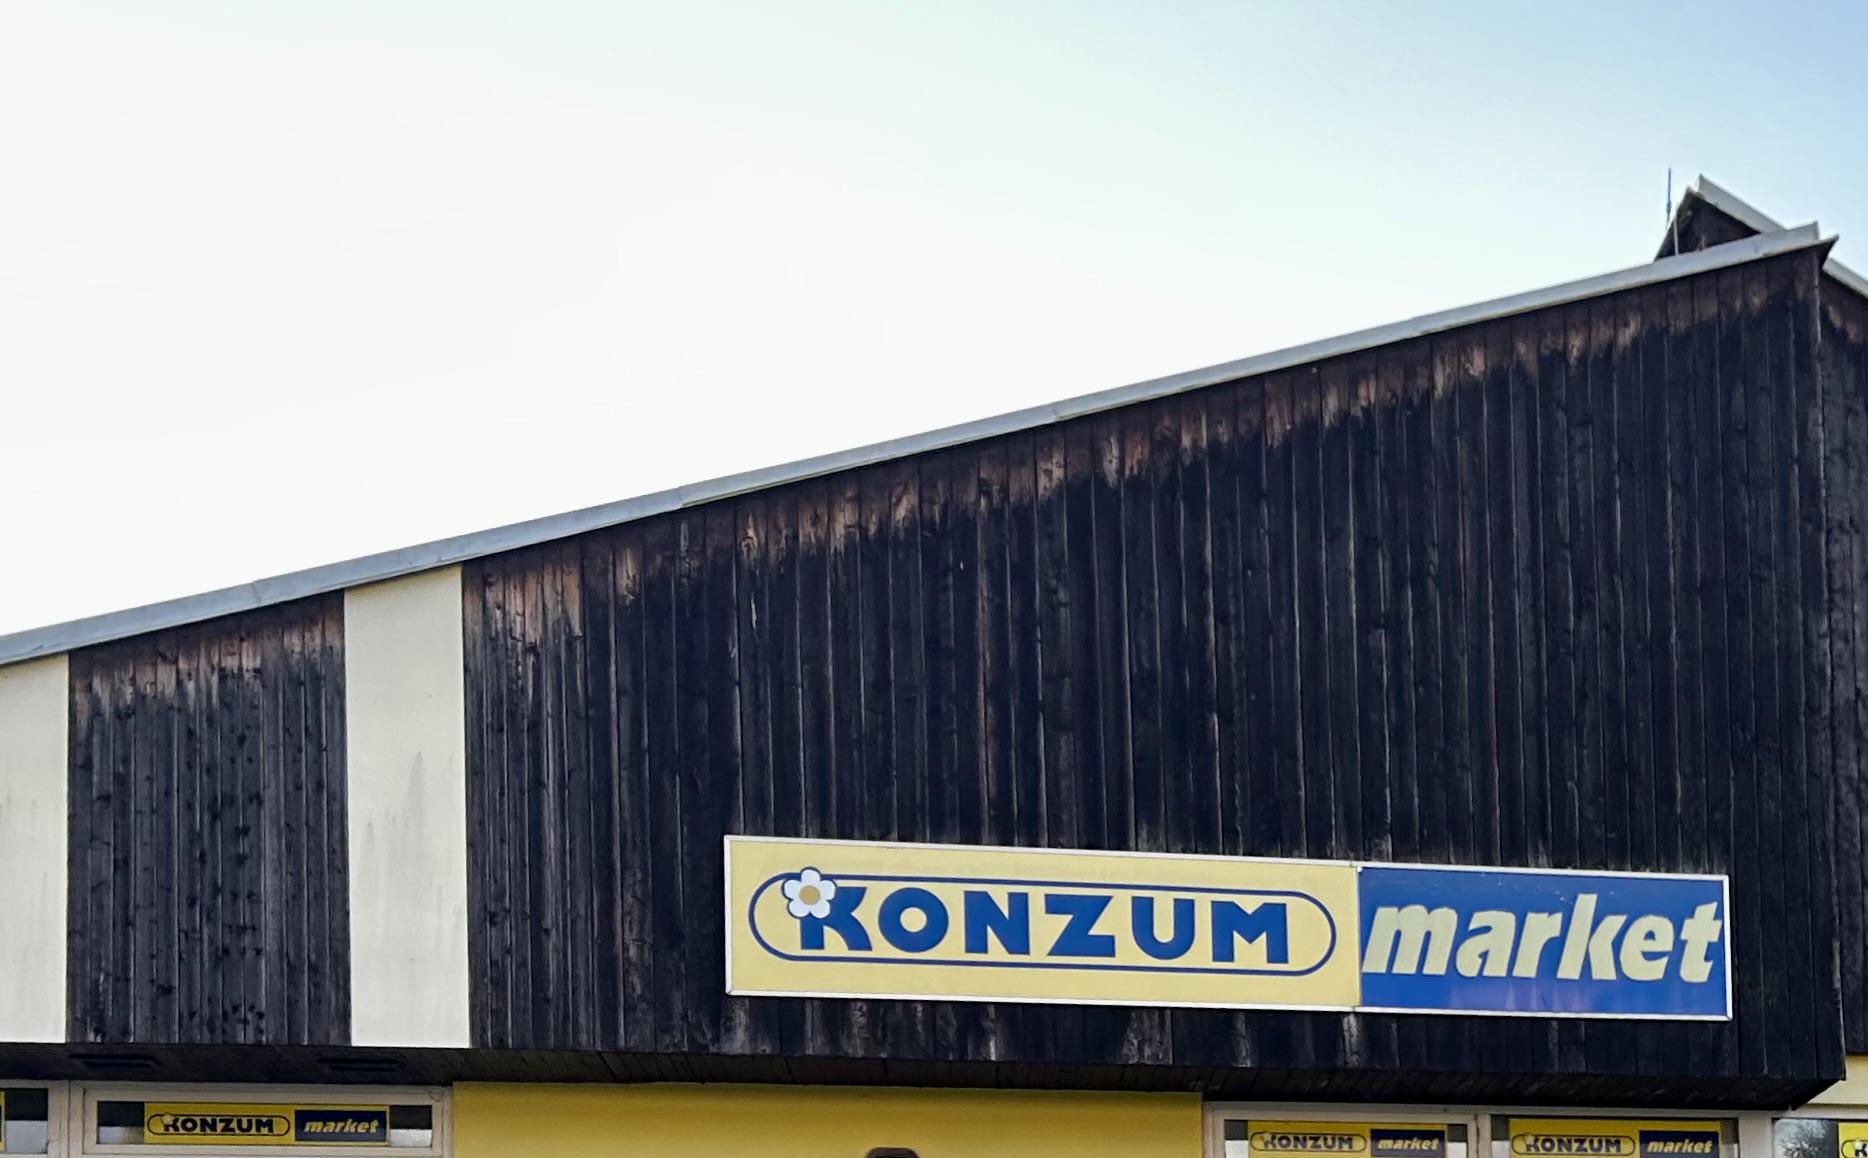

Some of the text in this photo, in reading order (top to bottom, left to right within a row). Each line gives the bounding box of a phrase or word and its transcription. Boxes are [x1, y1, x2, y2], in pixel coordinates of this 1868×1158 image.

[800, 886, 1723, 983] KONZUM market
[163, 1117, 380, 1134] KONZUM market
[1263, 1134, 1440, 1150] KONZUM market
[1526, 1137, 1713, 1154] KONZUM market
